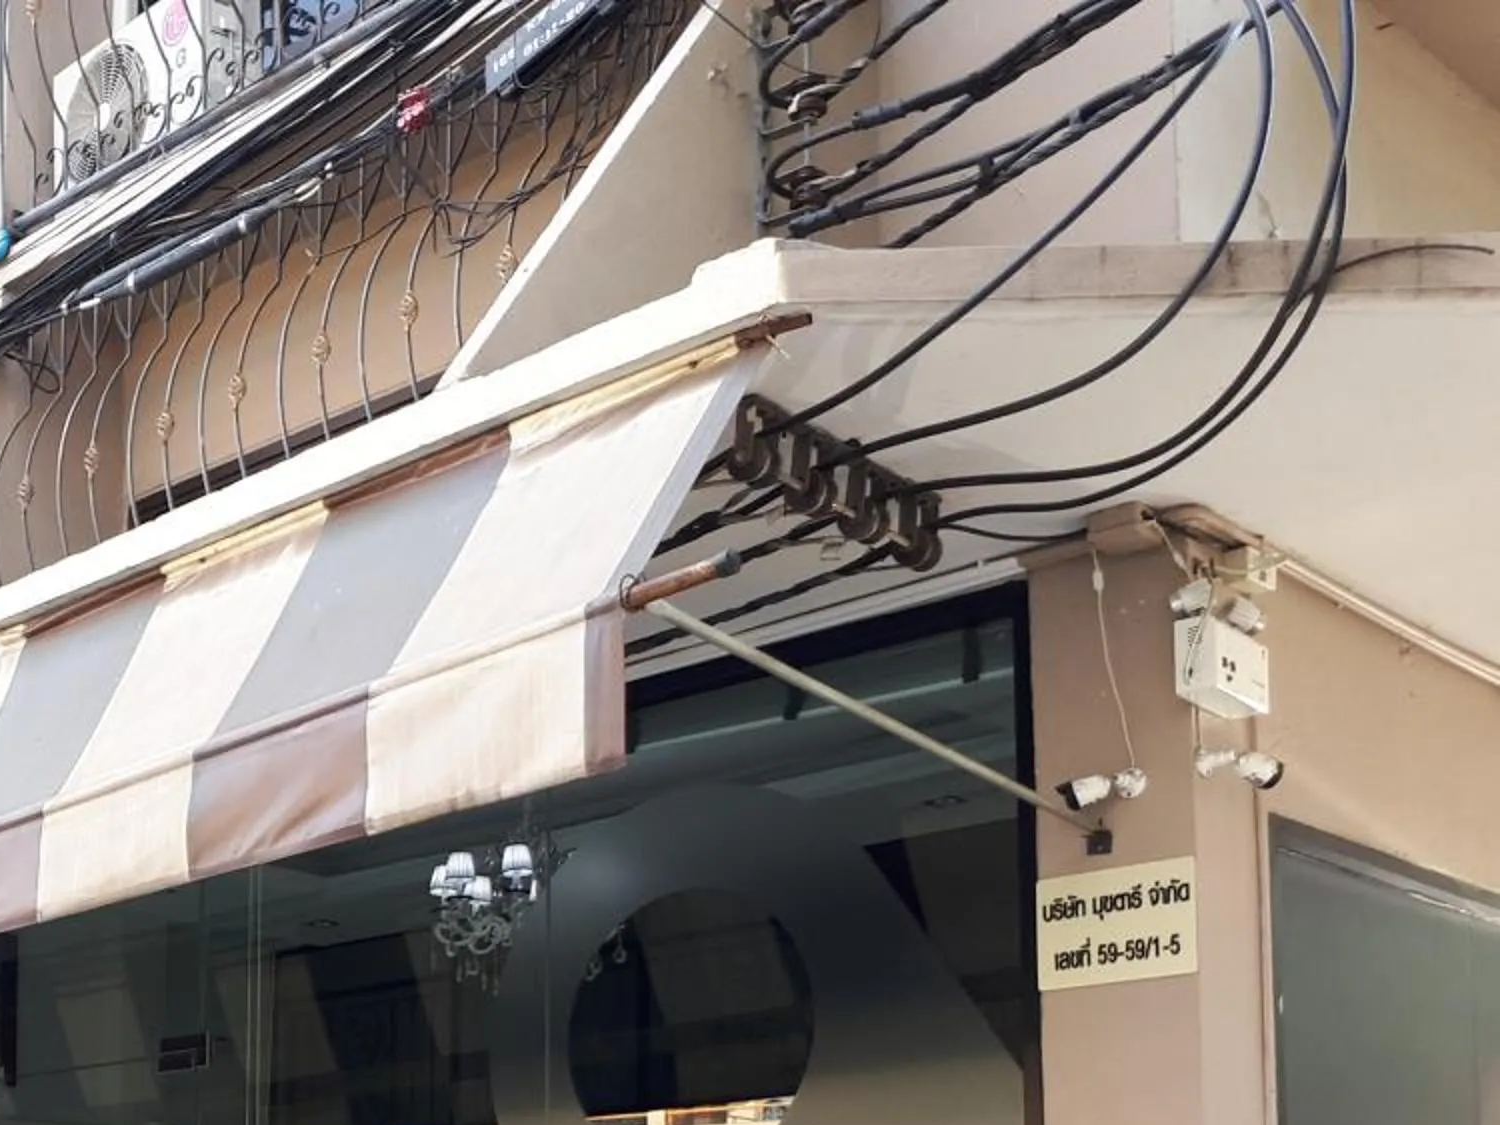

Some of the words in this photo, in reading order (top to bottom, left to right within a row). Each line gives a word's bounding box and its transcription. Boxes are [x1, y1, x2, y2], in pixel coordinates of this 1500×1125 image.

[1042, 894, 1087, 922] บริษัท
[1148, 878, 1191, 907] จำกัด
[1053, 936, 1092, 972] เลขที่
[1097, 933, 1182, 966] 59-59/1-5
